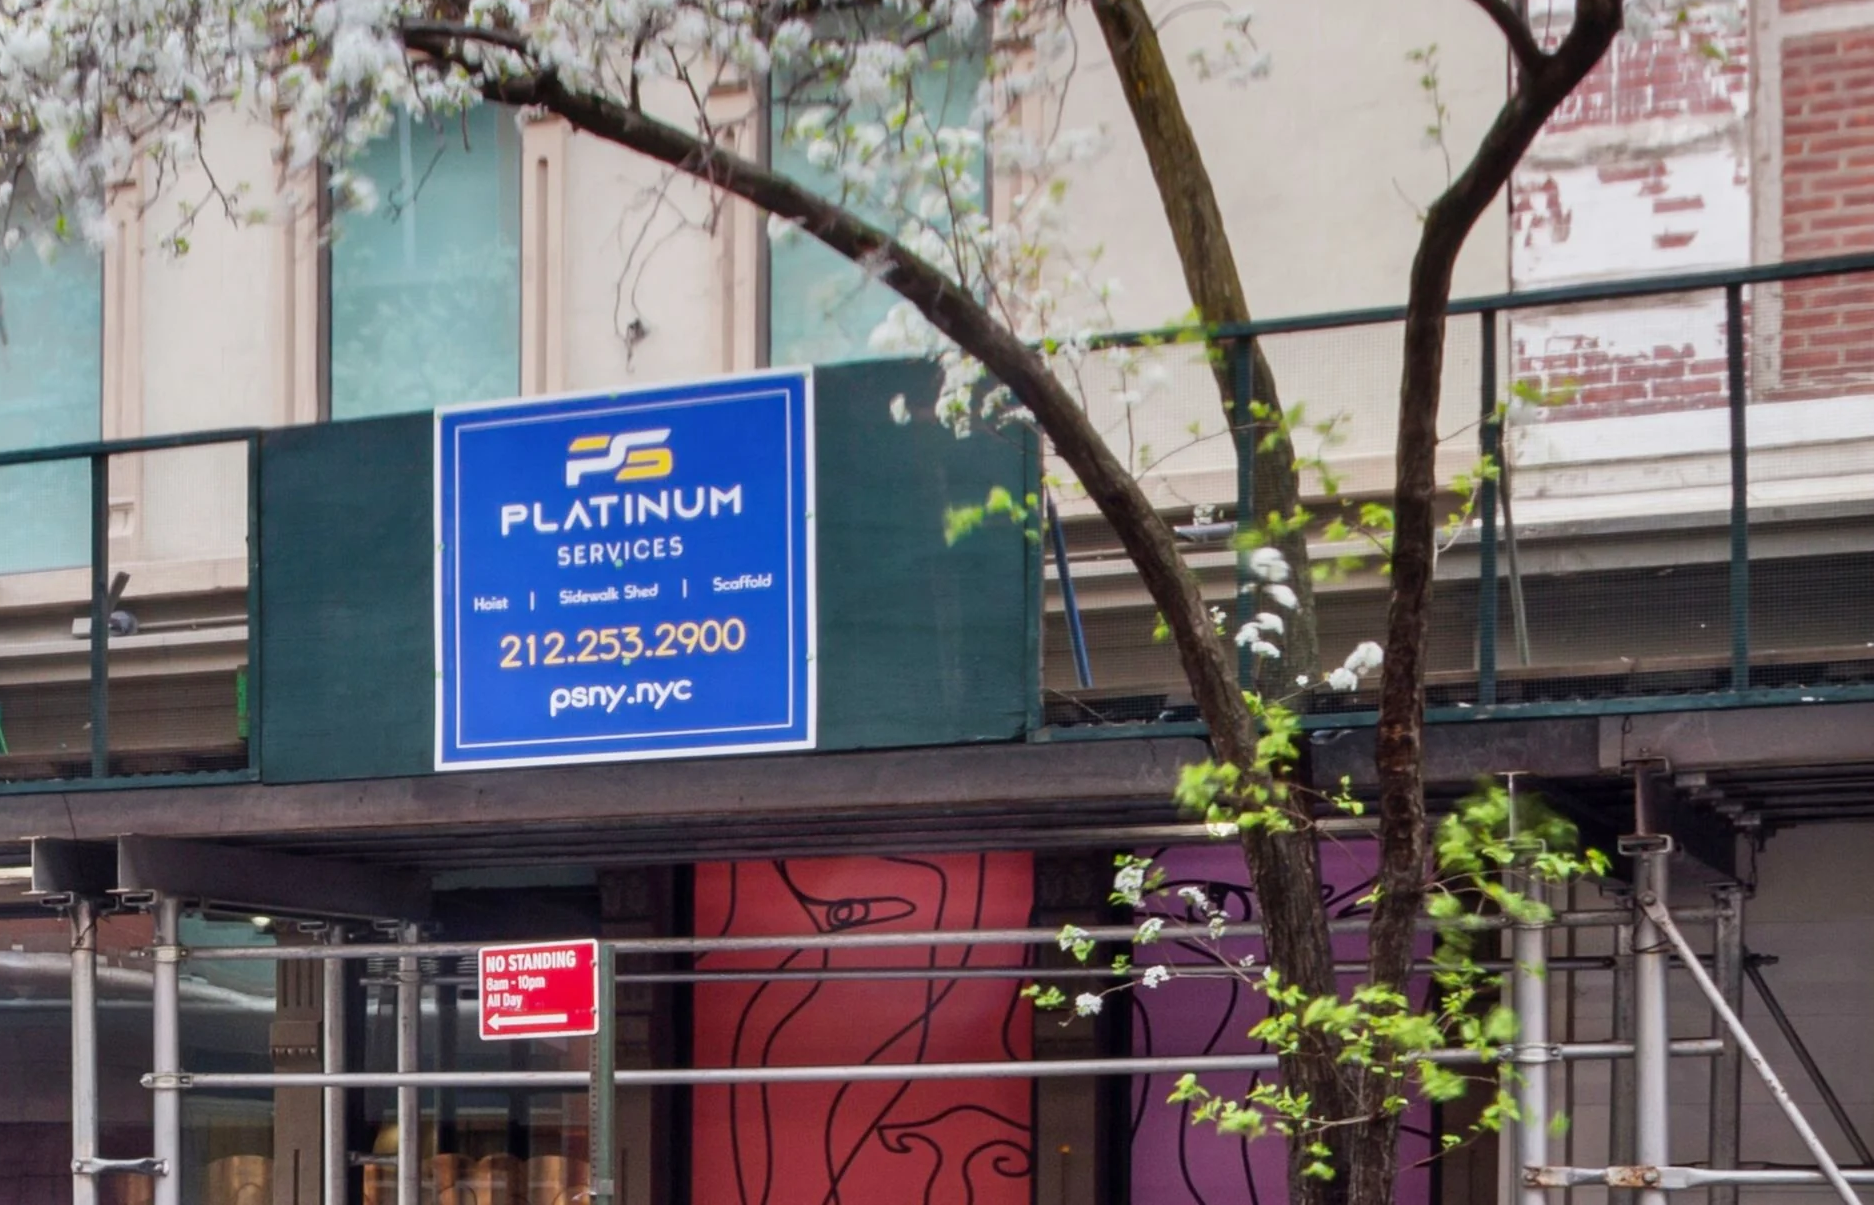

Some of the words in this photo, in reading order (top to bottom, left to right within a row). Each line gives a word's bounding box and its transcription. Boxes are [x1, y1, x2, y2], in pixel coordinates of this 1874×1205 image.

[501, 485, 742, 536] PLATINUM
[557, 536, 684, 567] SERVICES
[712, 573, 772, 593] Scaffold
[473, 596, 509, 612] Hoist
[559, 588, 619, 605] Sidewalk
[624, 584, 658, 600] Shed
[499, 618, 746, 668] 212.253.2900
[550, 679, 693, 717] psny.nyc
[486, 955, 505, 973] NO
[508, 950, 577, 972] STANDING
[486, 977, 509, 991] 8am
[517, 975, 546, 992] 10pm
[486, 994, 501, 1008] All
[502, 993, 524, 1009] Day
